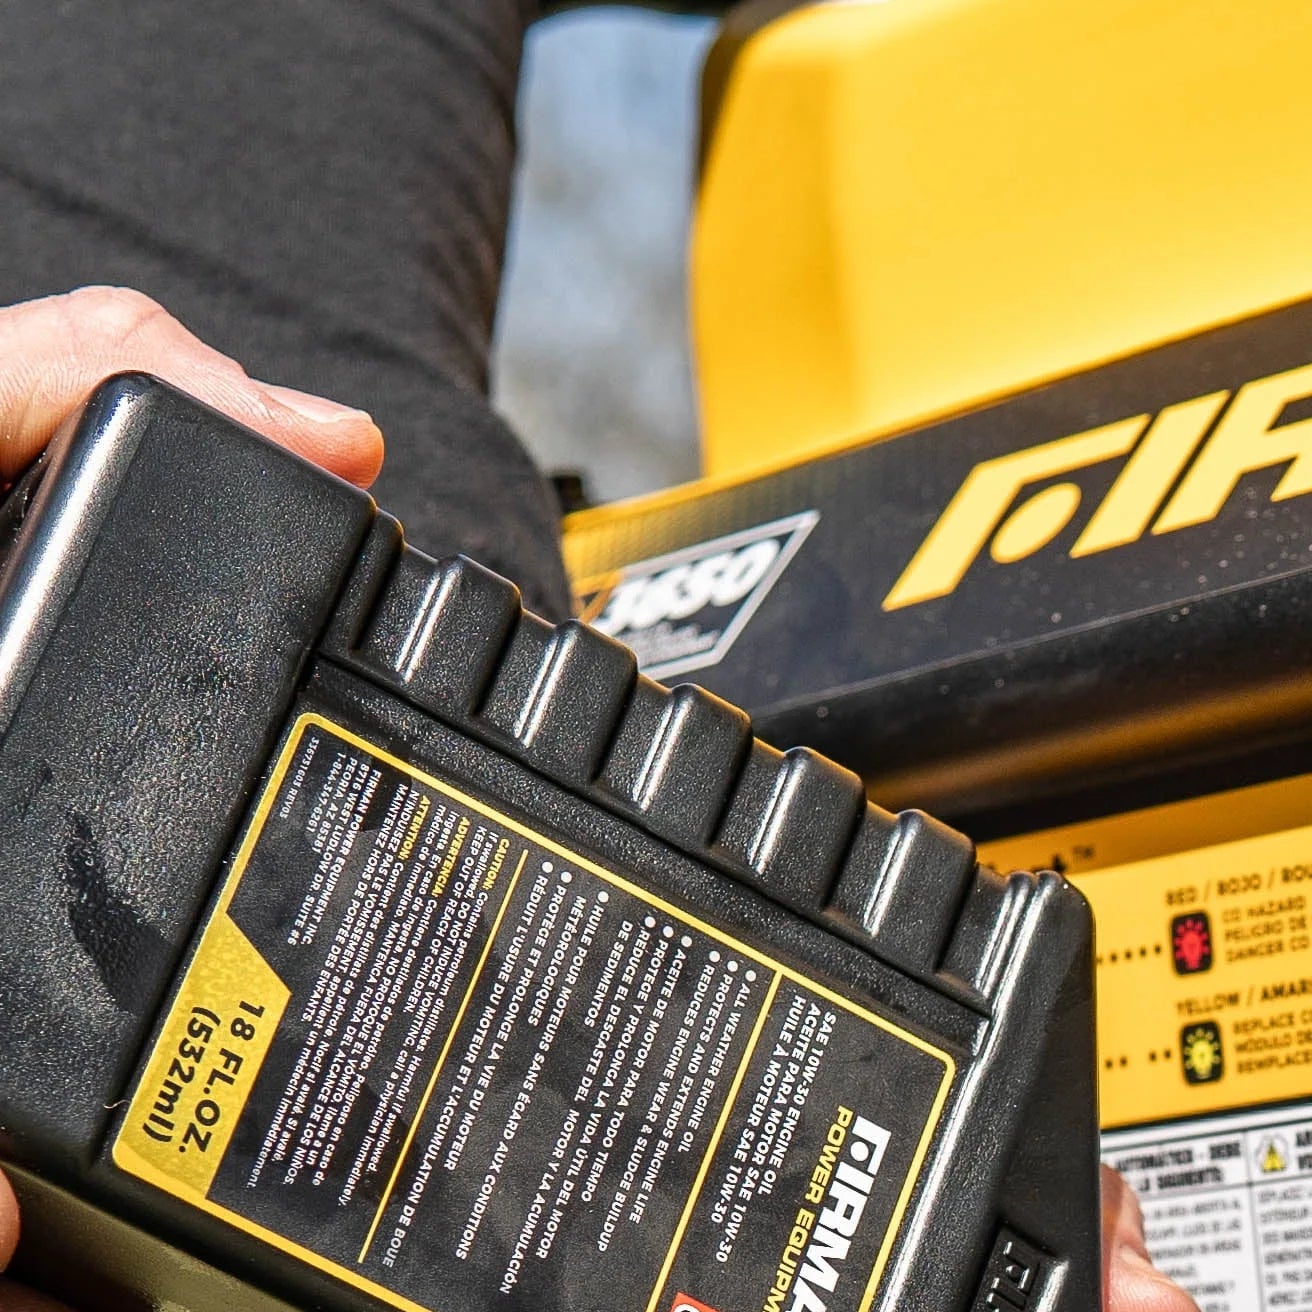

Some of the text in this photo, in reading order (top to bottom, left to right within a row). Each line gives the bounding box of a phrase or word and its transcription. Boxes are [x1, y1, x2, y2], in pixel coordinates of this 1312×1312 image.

[324, 801, 339, 821] AZ
[355, 768, 382, 814] FIRMAN
[286, 762, 370, 946] 8716 WEST LUDLOW DR. SUITE #6
[310, 819, 332, 854] 85381
[338, 812, 364, 856] POWER
[480, 837, 511, 891] CAUTION:
[310, 855, 347, 923] EQUIPMENT
[456, 900, 472, 920] DO
[462, 890, 489, 939] Contains
[1165, 885, 1199, 907] RED
[427, 944, 454, 990] INDUCE
[438, 937, 468, 997] petroleum
[445, 919, 464, 946] NOT
[526, 894, 587, 1026] MÉTÉOROLOGIQUES
[583, 919, 634, 1028] DE SEDIMENTOS
[1175, 992, 1240, 1018] YELLOW
[393, 1048, 409, 1072] call
[414, 996, 446, 1052] distillates.
[442, 883, 567, 1171] PROTÈGE ET PROLONGE LA VIE DU MOTEUR
[1233, 1012, 1295, 1036] REPLACE
[141, 1005, 222, 1143] (532ml)
[177, 999, 265, 1153] 18 FL.OZ.
[381, 873, 549, 1268] RÉDUIT L'USURE DU MOTEUR ET L'ACCUMULATION DE BOUE
[394, 1054, 422, 1102] Harmful
[454, 903, 605, 1260] HUILE POUR MOTEURS SANS ÉGARD AUX CONDITIONS
[534, 938, 669, 1259] PROTEGE Y PROLONGA LA VIDA ÚTIL DEL MOTOR
[580, 947, 687, 1202] ACEITE DE MOTOR PARA TODO TIEMPO
[627, 972, 734, 1224] PROTECTS AND EXTENDS ENGINE LIFE
[676, 981, 751, 1153] ALL WEATHER ENGINE OIL
[756, 1010, 837, 1195] SAE 10W-30 ENGINE OIL
[365, 1111, 397, 1172] swallowed.
[367, 1079, 396, 1134] physician
[498, 928, 651, 1294] REDUCE EL DESGASTE DEL MOTOR Y LA ACUMULACIÓN
[596, 963, 715, 1252] REDUCES ENGINE WEAR & SLUDGE BUILDUP
[709, 994, 807, 1224] HUILE À MOTEUR SAE 10W-30
[714, 1001, 822, 1263] ACEITE PARA MOTOR SAE 10W-30
[336, 1134, 376, 1210] immediately.
[803, 1104, 854, 1204] POWER
